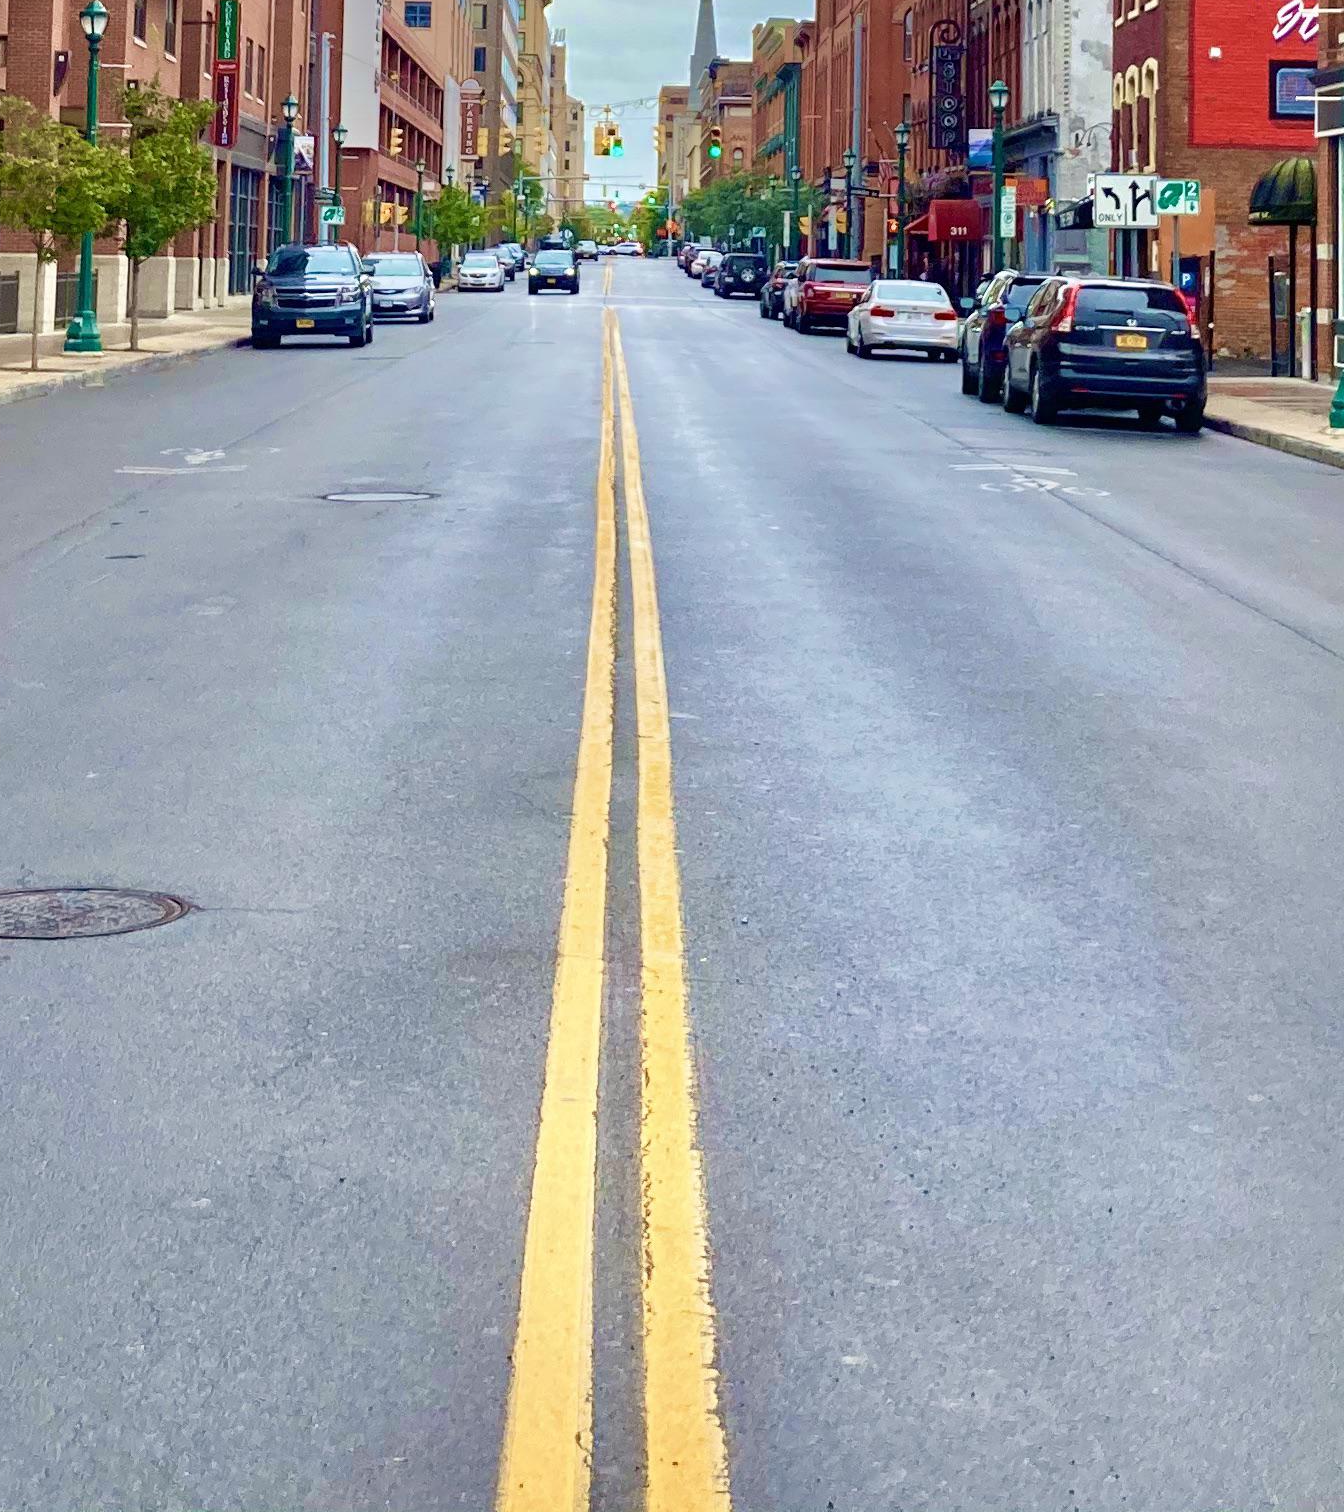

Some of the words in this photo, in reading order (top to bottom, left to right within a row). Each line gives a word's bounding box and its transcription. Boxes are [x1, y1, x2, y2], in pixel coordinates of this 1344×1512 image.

[465, 102, 474, 154] PARKING
[1187, 182, 1197, 196] 2
[1098, 212, 1123, 223] ONLY
[950, 226, 967, 236] 311
[1182, 272, 1191, 286] P
